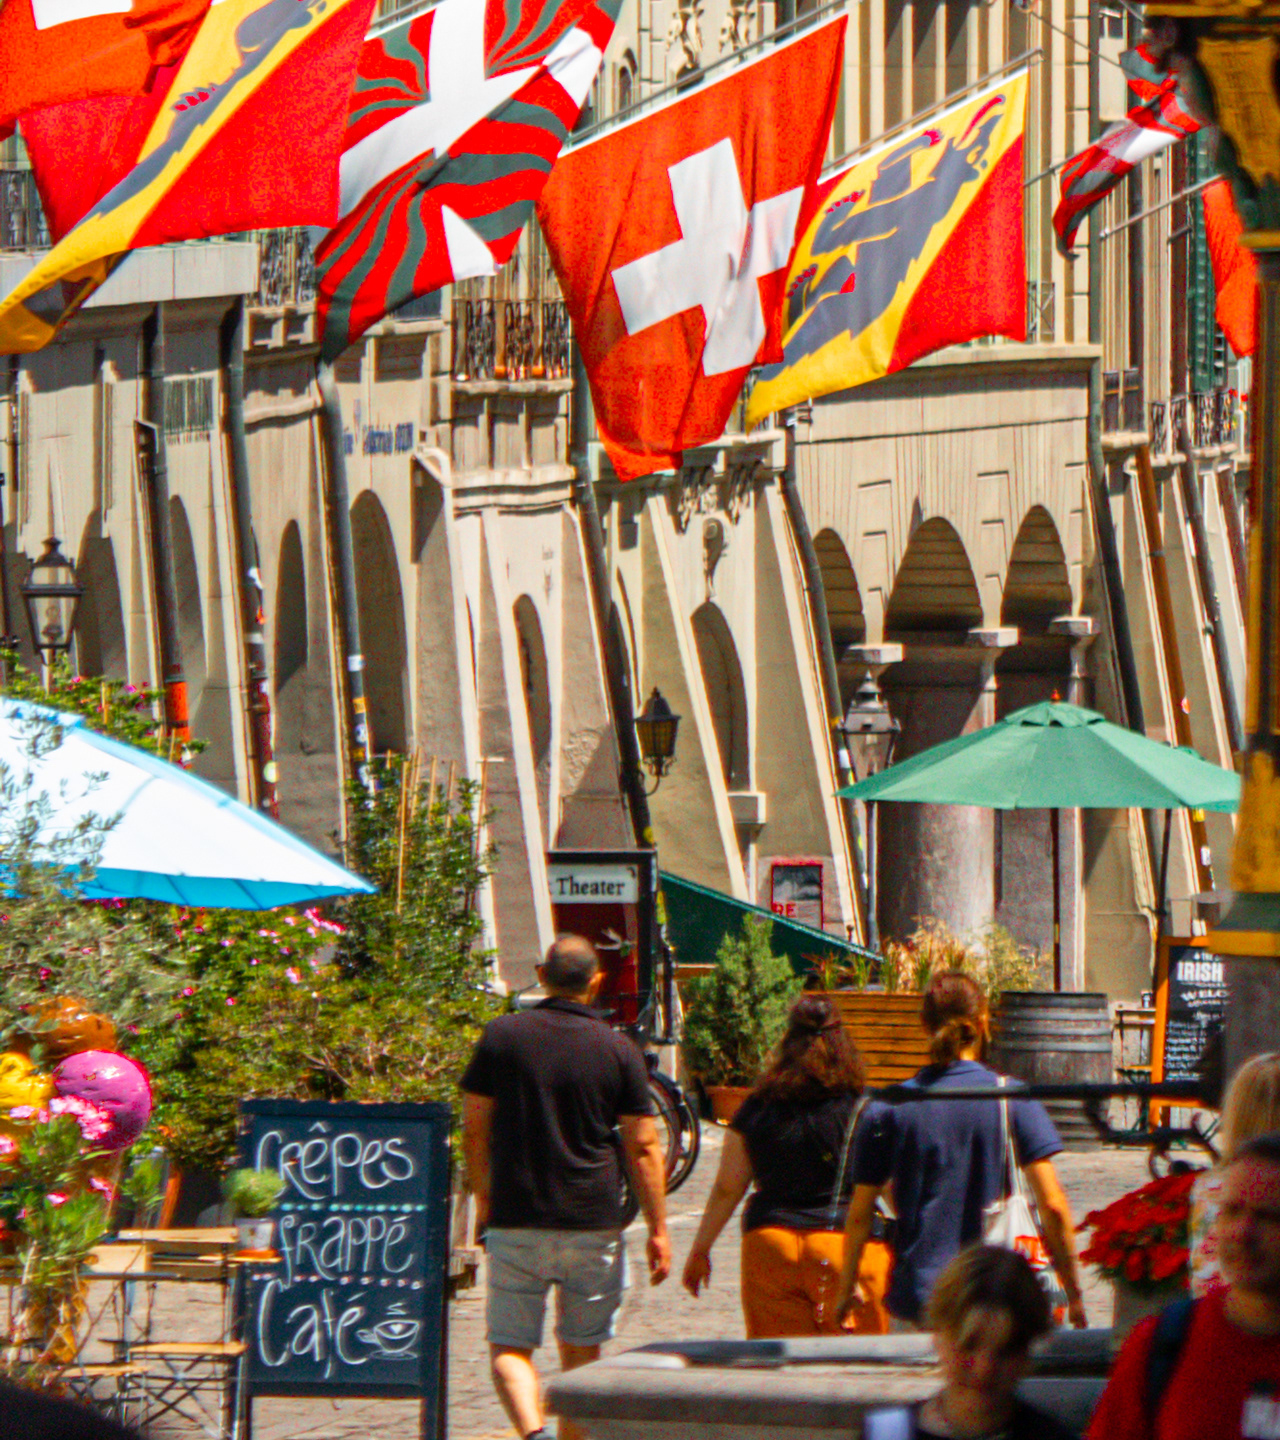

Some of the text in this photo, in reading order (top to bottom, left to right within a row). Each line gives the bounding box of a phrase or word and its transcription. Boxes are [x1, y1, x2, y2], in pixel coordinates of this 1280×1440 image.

[556, 875, 625, 896] Theater
[1176, 961, 1224, 982] IRISH
[258, 1278, 369, 1379] Café
